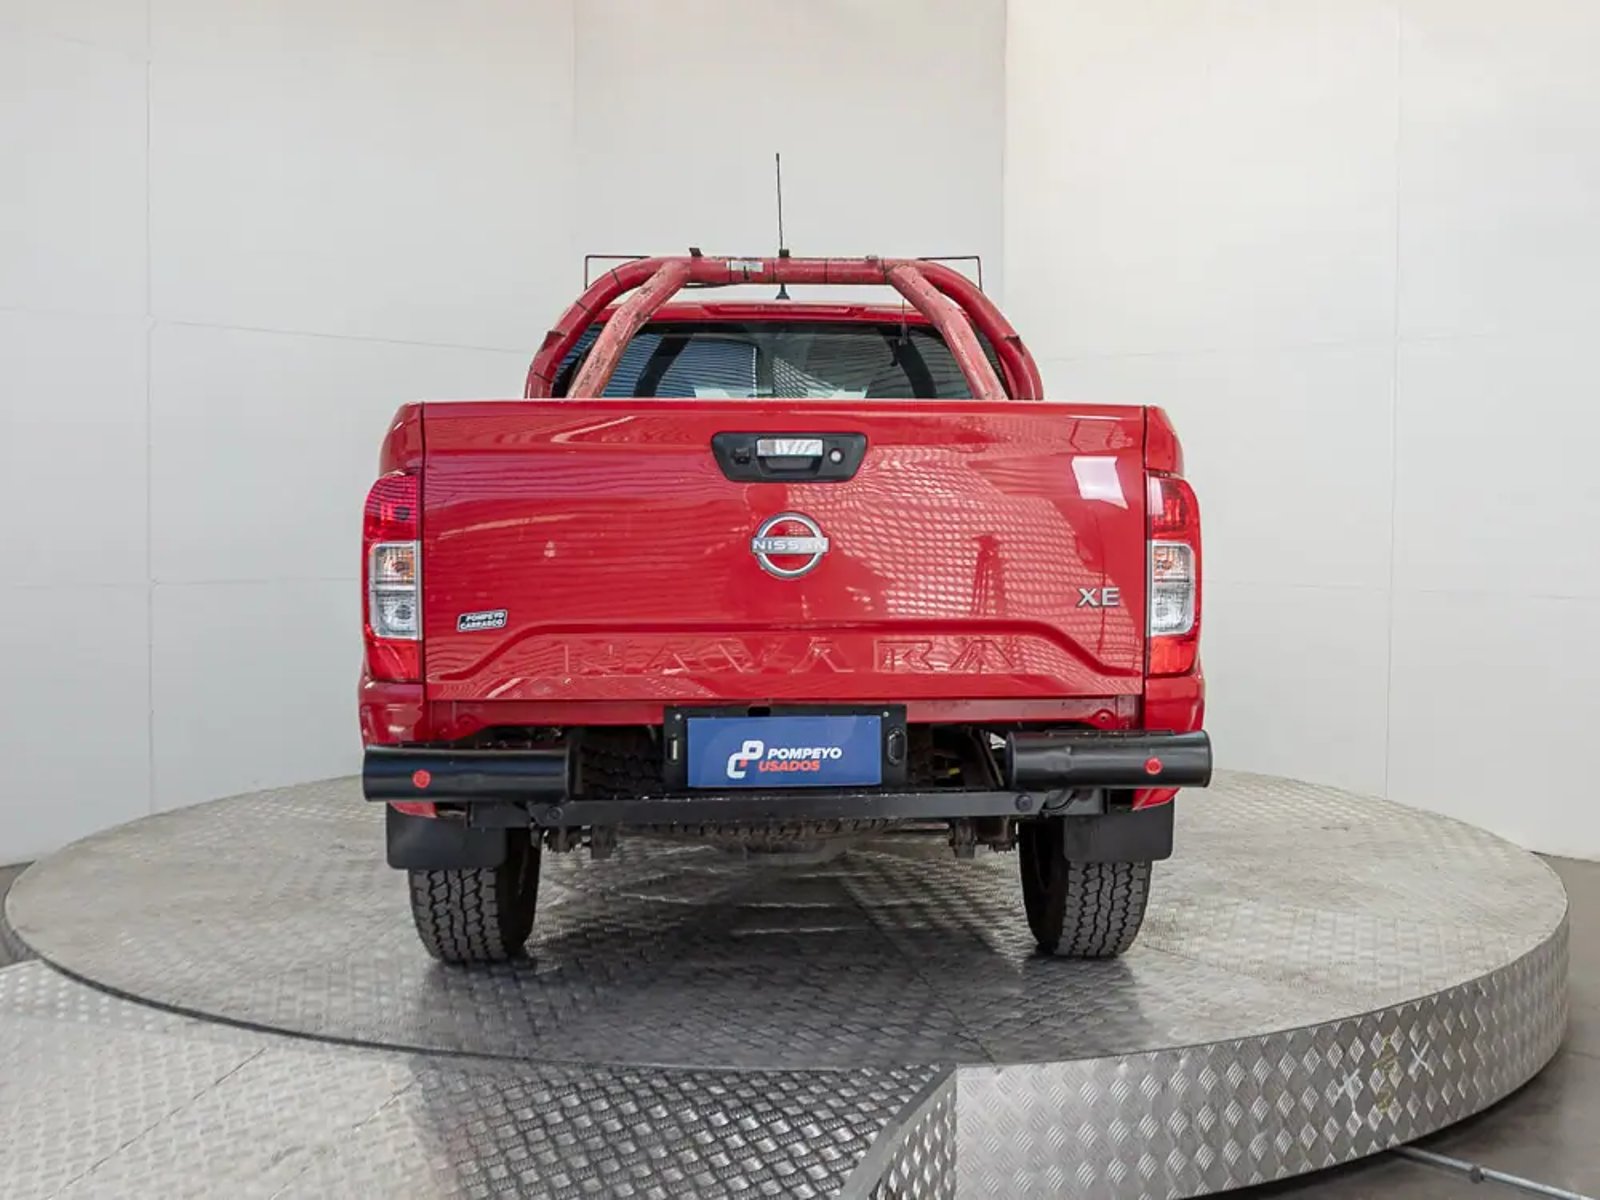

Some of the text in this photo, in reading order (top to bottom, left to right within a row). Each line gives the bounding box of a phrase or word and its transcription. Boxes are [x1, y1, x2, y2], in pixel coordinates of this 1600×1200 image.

[1077, 587, 1120, 607] XE
[767, 747, 842, 760] POMPEYO
[758, 760, 820, 772] USADOS
